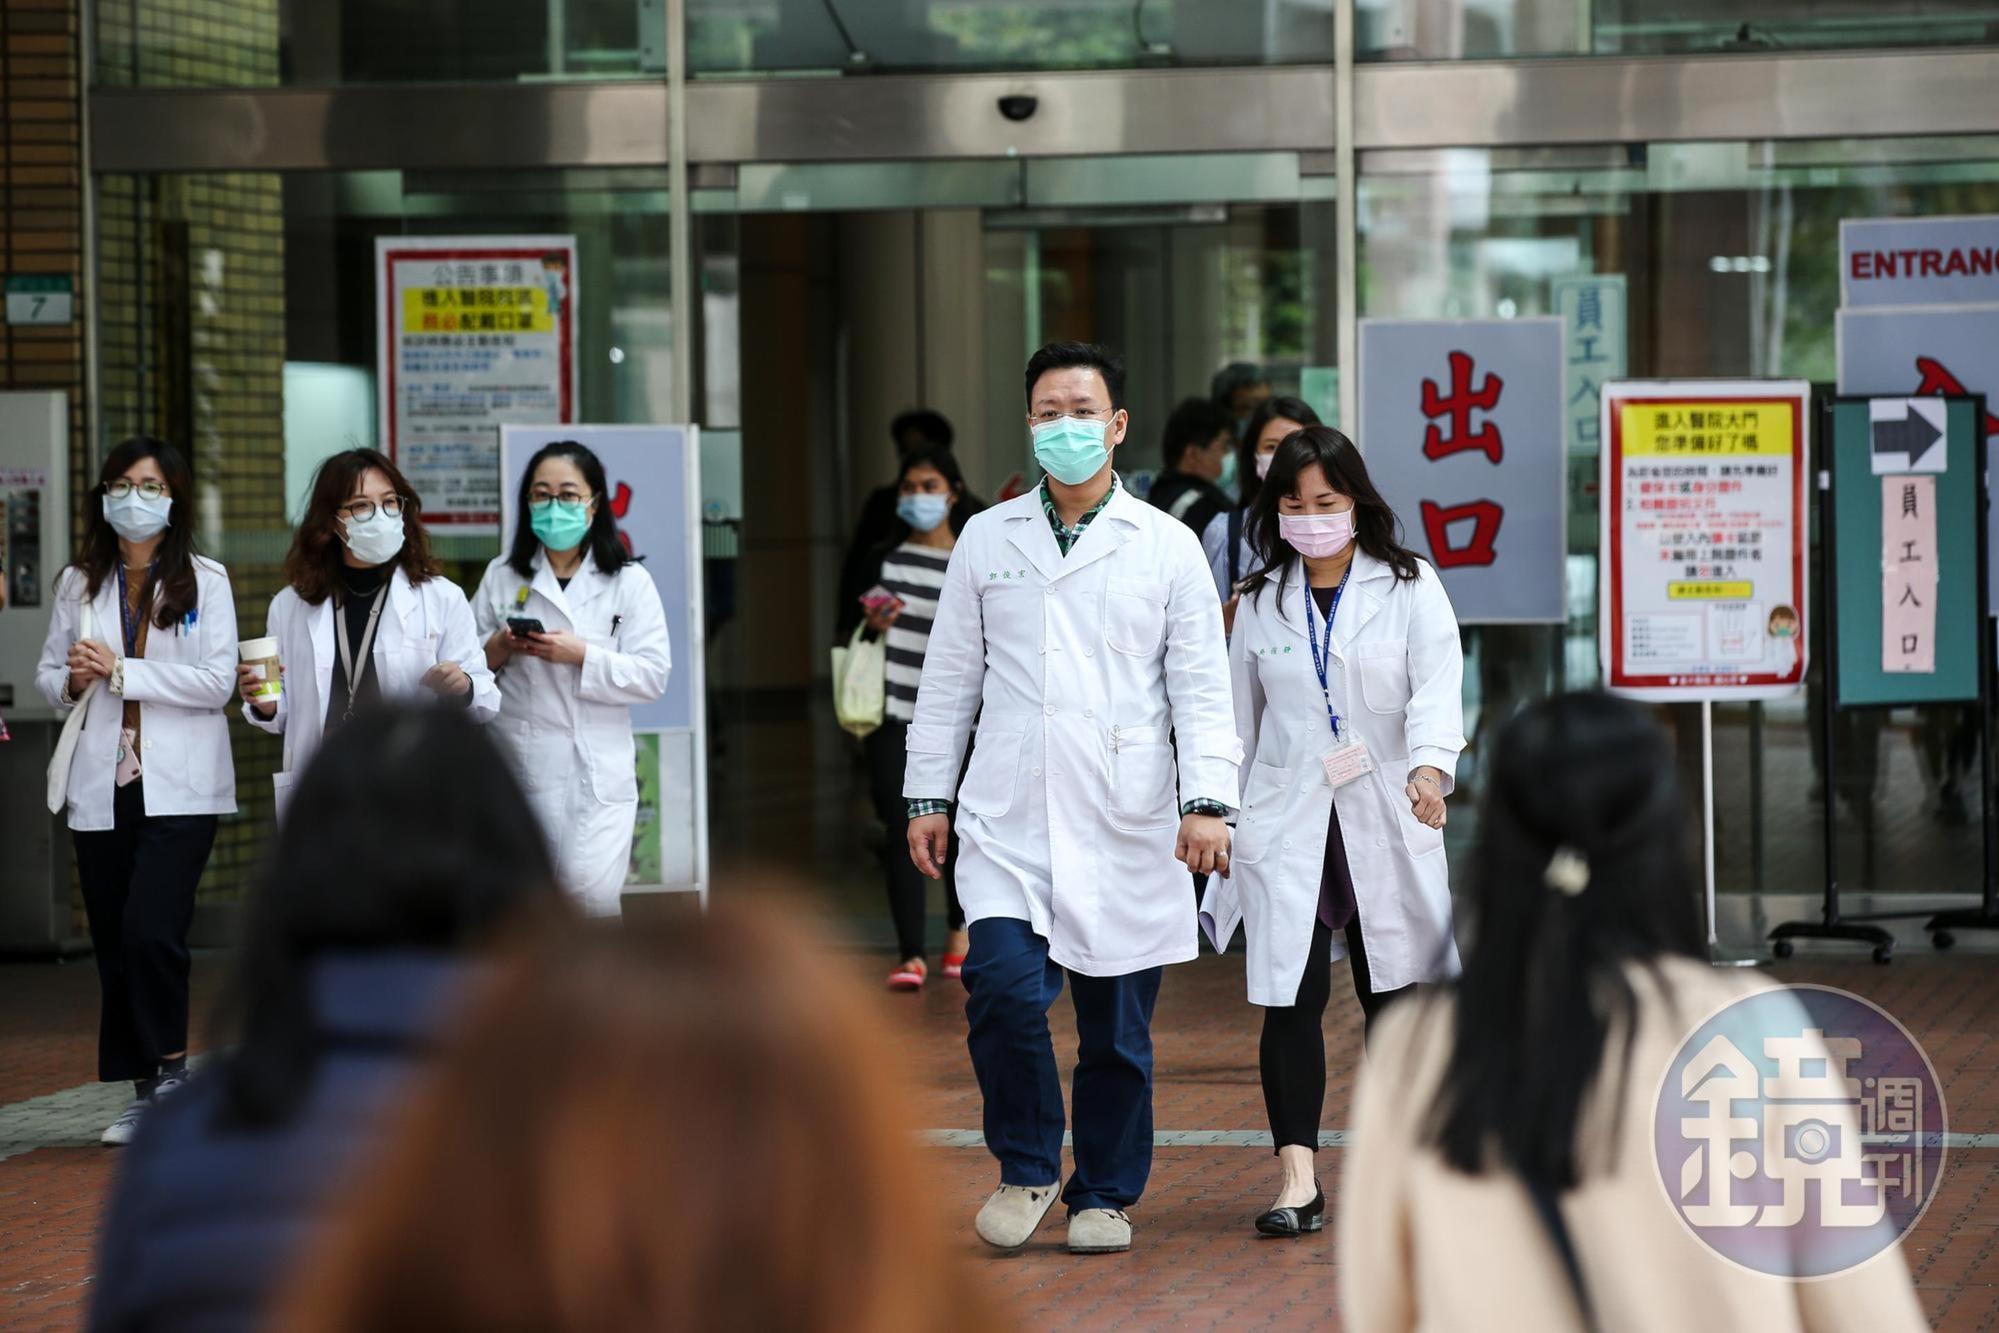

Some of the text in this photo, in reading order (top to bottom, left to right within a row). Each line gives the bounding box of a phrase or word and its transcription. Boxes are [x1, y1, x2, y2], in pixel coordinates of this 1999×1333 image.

[432, 264, 523, 285] 公告事項
[1851, 247, 1999, 280] ENTRAN
[31, 296, 48, 320] 7
[1568, 285, 1608, 443] 員工入口
[1654, 410, 1759, 429] 進入醫院大門
[1654, 433, 1759, 451] 您準備好了嗎
[1420, 350, 1505, 570] 出口
[1898, 483, 1923, 655] 員工入口
